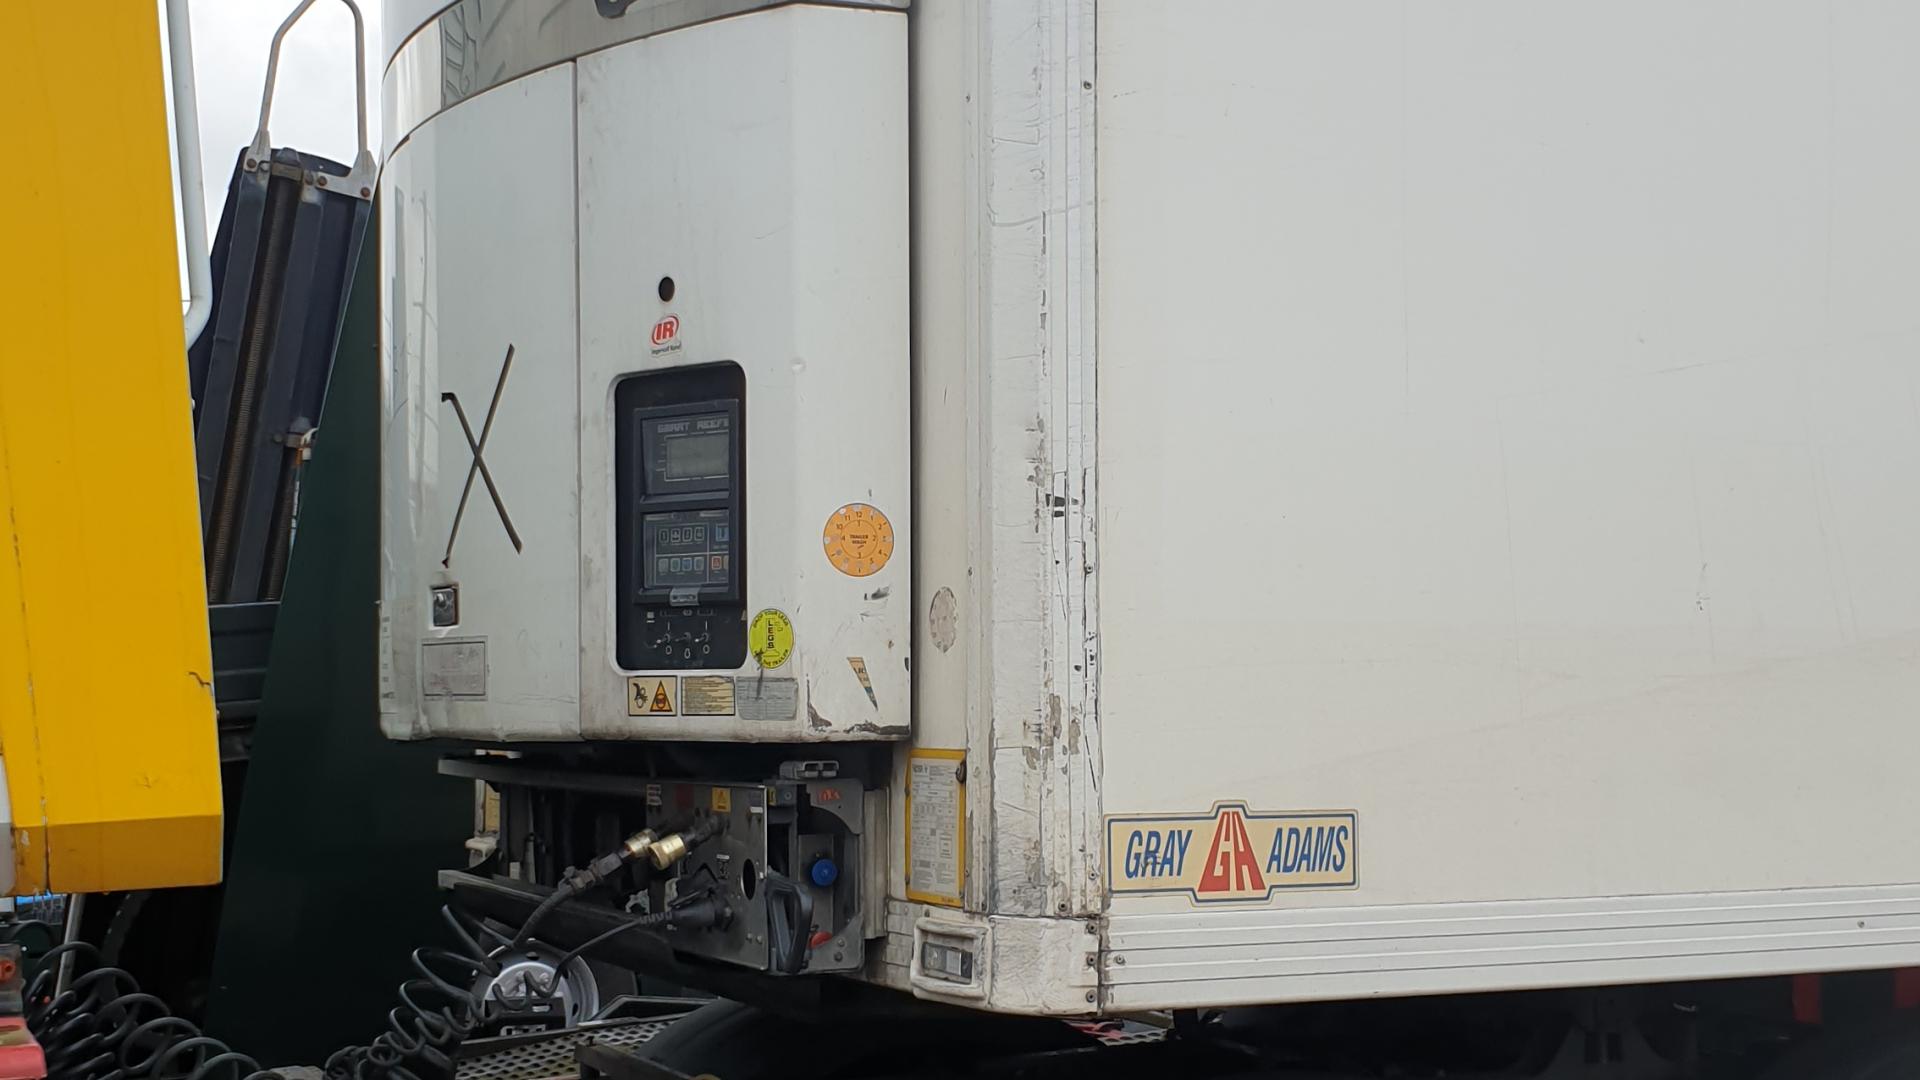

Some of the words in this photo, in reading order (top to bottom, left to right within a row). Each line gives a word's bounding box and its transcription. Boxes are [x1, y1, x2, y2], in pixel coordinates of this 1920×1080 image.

[656, 321, 675, 341] IR
[767, 619, 775, 649] LEGS
[1125, 829, 1193, 878] GRAY
[1266, 825, 1349, 873] ADAMS
